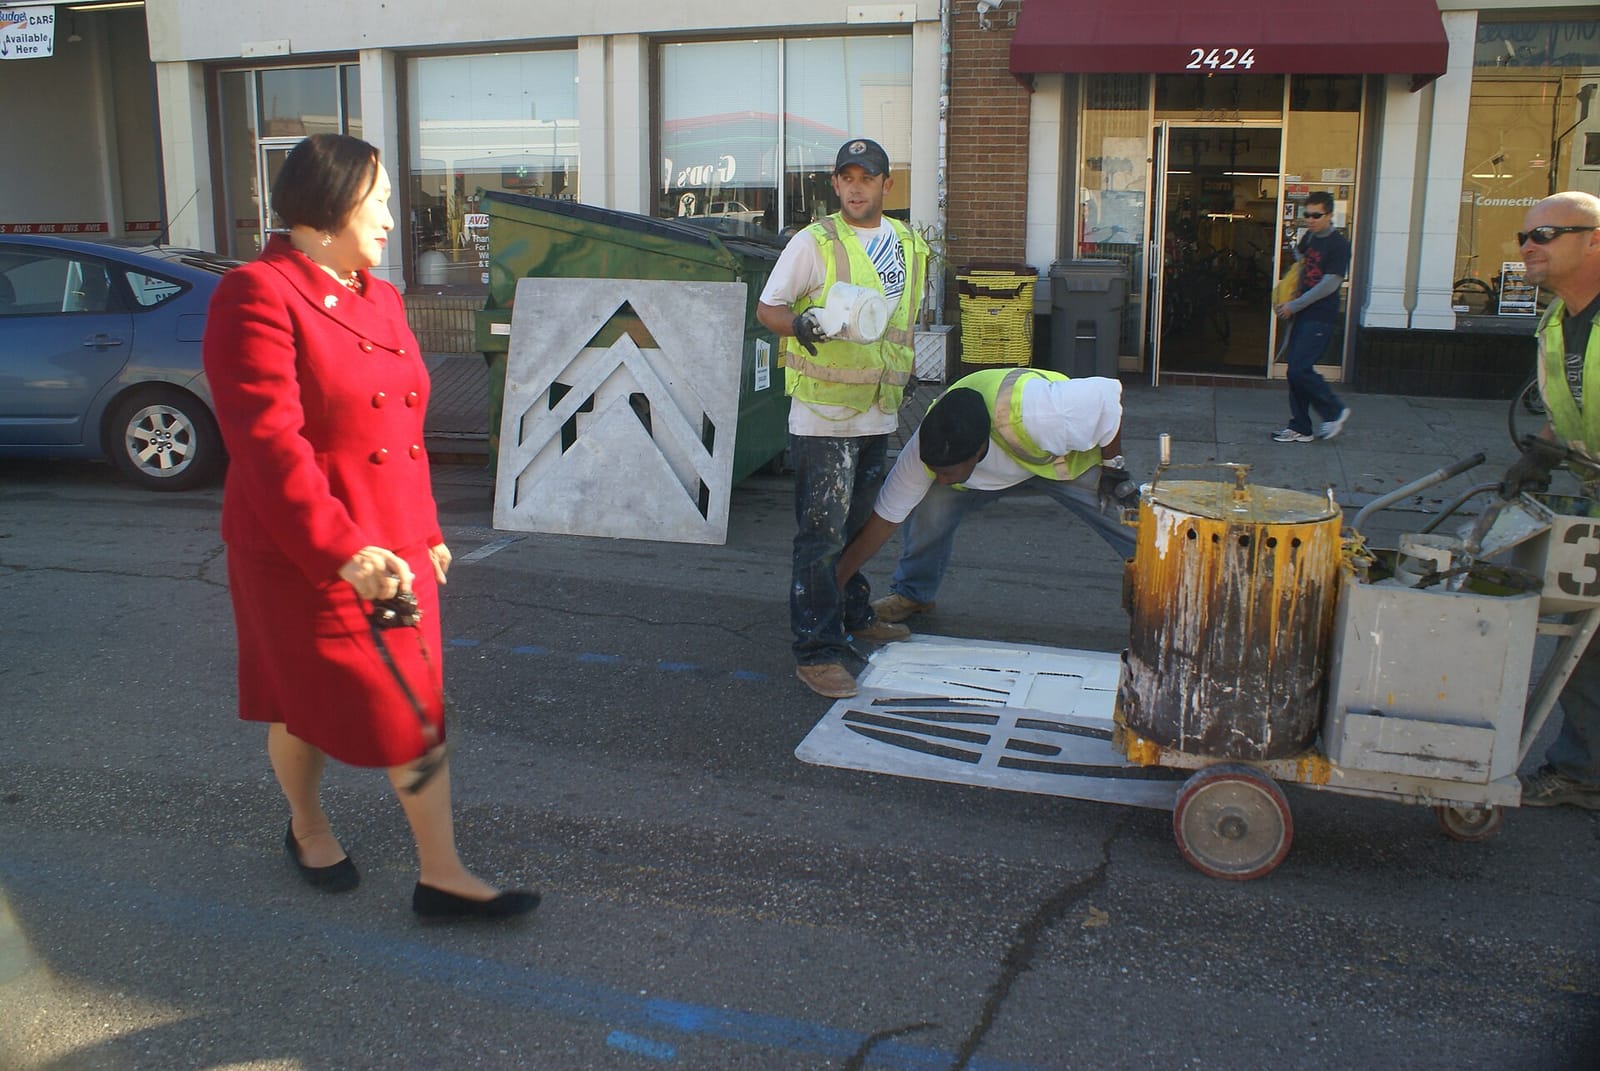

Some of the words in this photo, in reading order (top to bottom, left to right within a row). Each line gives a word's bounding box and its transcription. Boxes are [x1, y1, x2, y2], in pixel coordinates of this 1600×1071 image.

[29, 15, 54, 25] CARS
[6, 34, 48, 43] Available
[16, 45, 38, 54] Here
[1186, 48, 1255, 69] 2424
[469, 216, 489, 225] AVIS
[13, 224, 31, 233] AVIS
[38, 224, 55, 233] AVIS
[62, 224, 78, 232] AVIS
[84, 223, 100, 232] AVIS
[1558, 523, 1600, 597] 3
